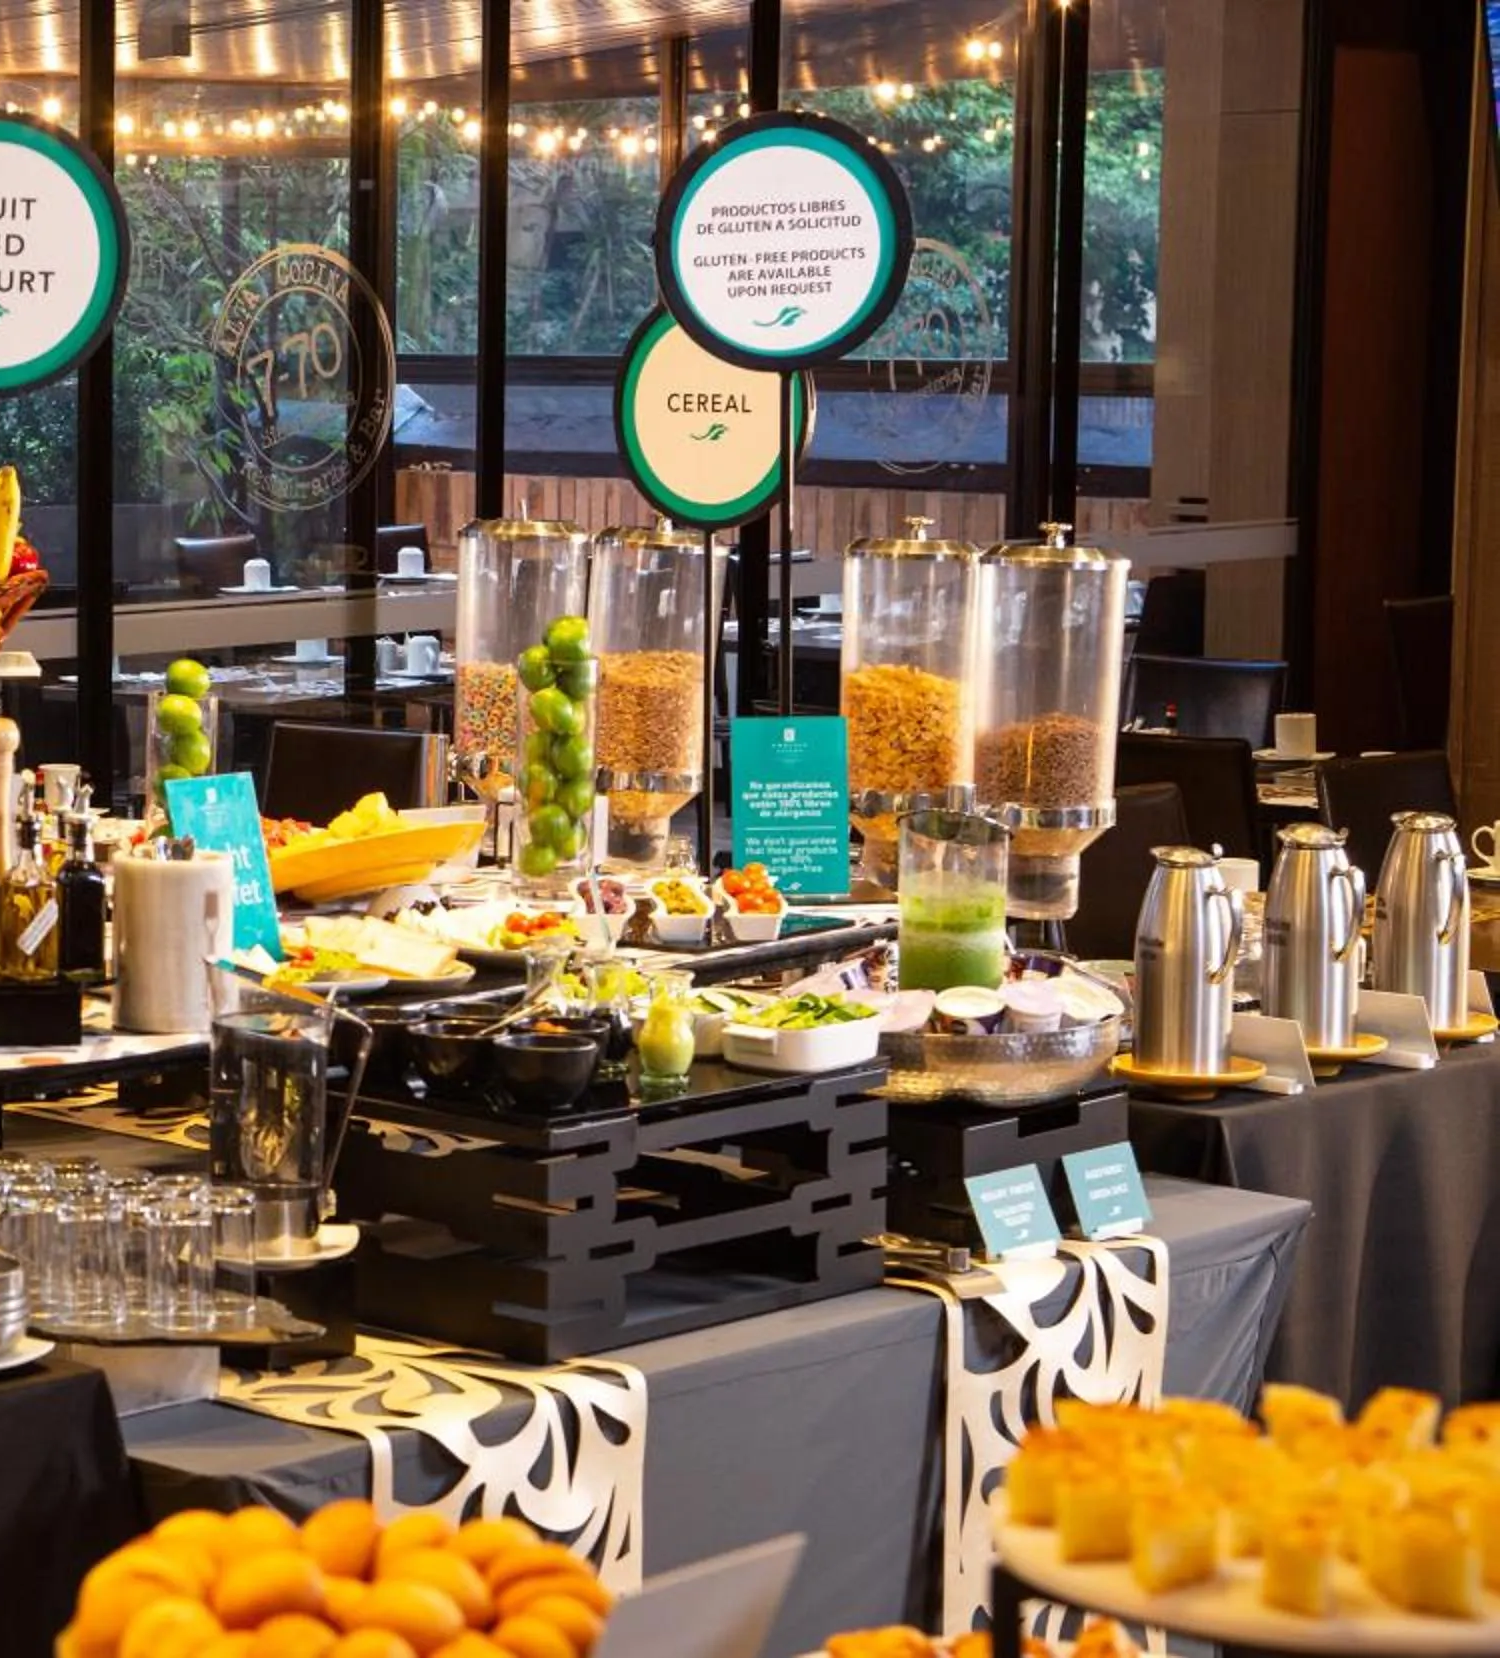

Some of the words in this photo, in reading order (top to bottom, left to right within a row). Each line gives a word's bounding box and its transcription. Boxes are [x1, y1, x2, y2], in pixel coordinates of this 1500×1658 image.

[711, 202, 797, 218] PRODUCTOS
[799, 199, 846, 214] LIBRES
[696, 223, 715, 236] DE
[717, 220, 772, 234] GLUTEN
[775, 219, 785, 232] A
[788, 215, 862, 231] SOLICITUD
[791, 247, 866, 263] PRODUCTS
[277, 259, 349, 303] COCINA
[727, 269, 755, 282] ARE
[757, 265, 833, 281] AVAILABLE
[727, 285, 767, 298] UPON
[770, 281, 833, 296] REQUEST
[667, 394, 752, 413] CEREAL
[359, 387, 385, 441] Bar
[749, 781, 763, 791] No
[742, 791, 760, 801] que
[790, 789, 839, 801] productos
[778, 800, 802, 809] 100%
[803, 799, 831, 808] libres
[759, 809, 771, 817] de
[745, 837, 760, 846] We
[745, 847, 764, 855] that
[767, 847, 793, 855] these
[795, 846, 838, 857] products
[771, 857, 787, 865] are
